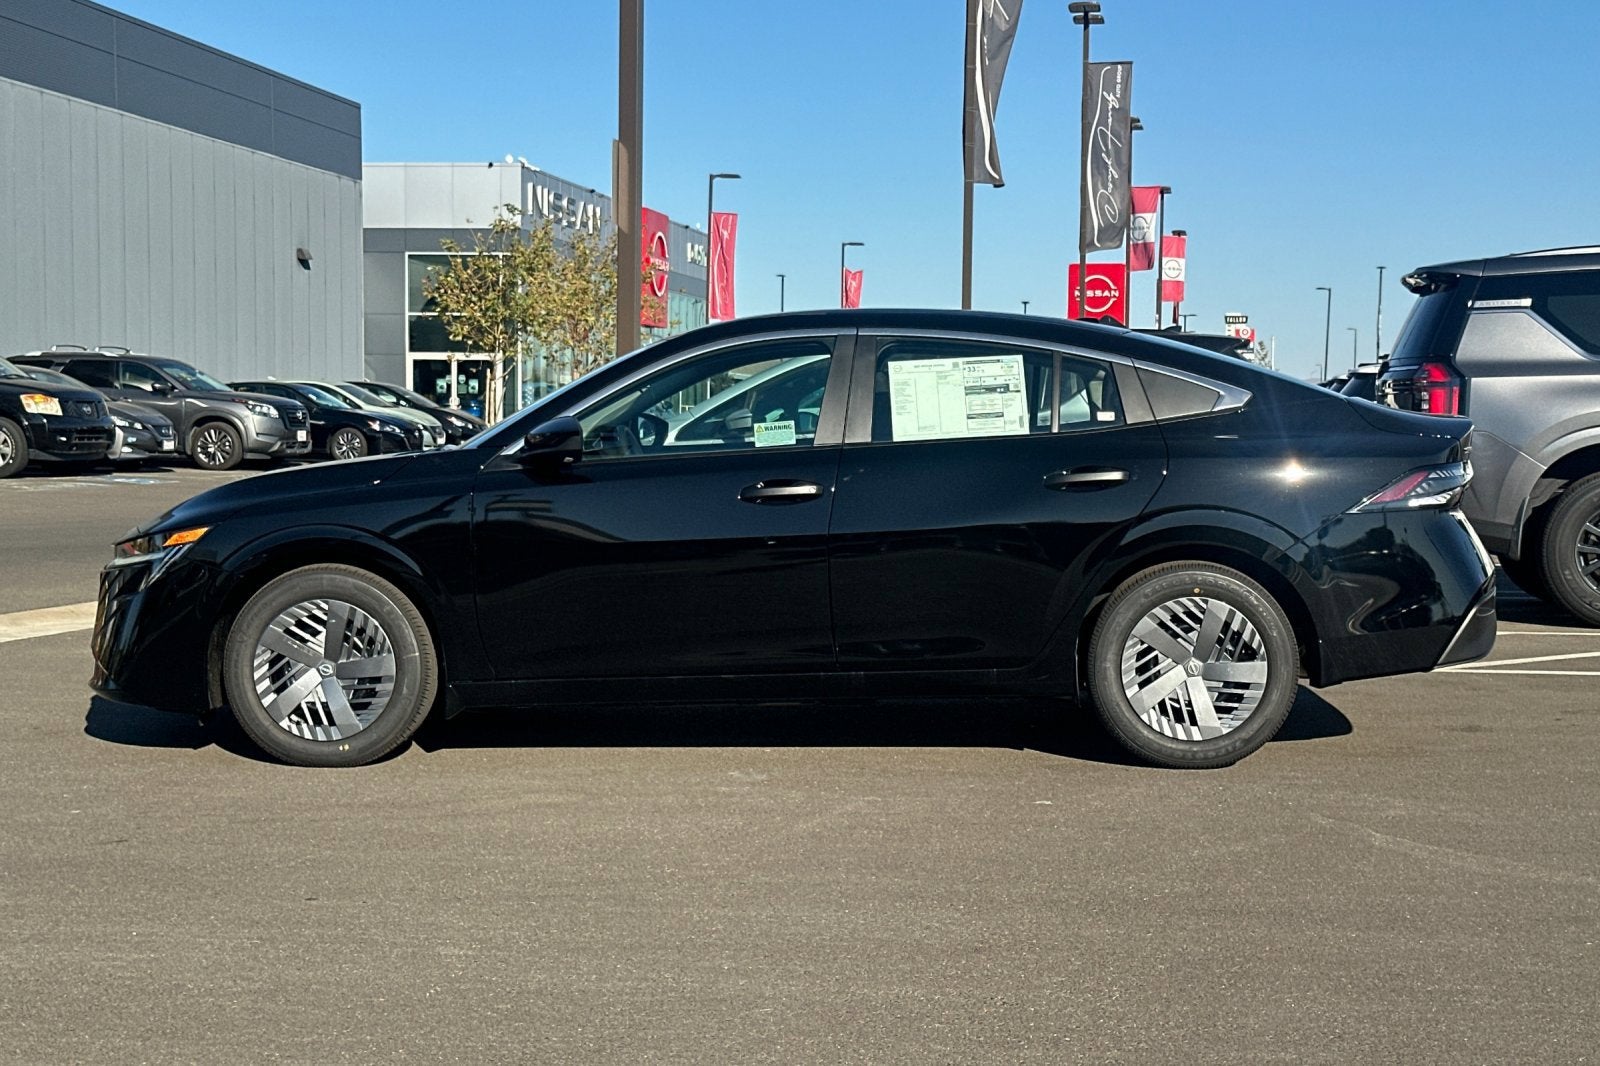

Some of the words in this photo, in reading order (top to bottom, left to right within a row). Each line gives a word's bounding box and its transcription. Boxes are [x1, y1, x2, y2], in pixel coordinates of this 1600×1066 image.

[527, 182, 601, 234] NISSAN
[1074, 289, 1119, 297] NSSAN
[764, 423, 793, 432] WARNING
